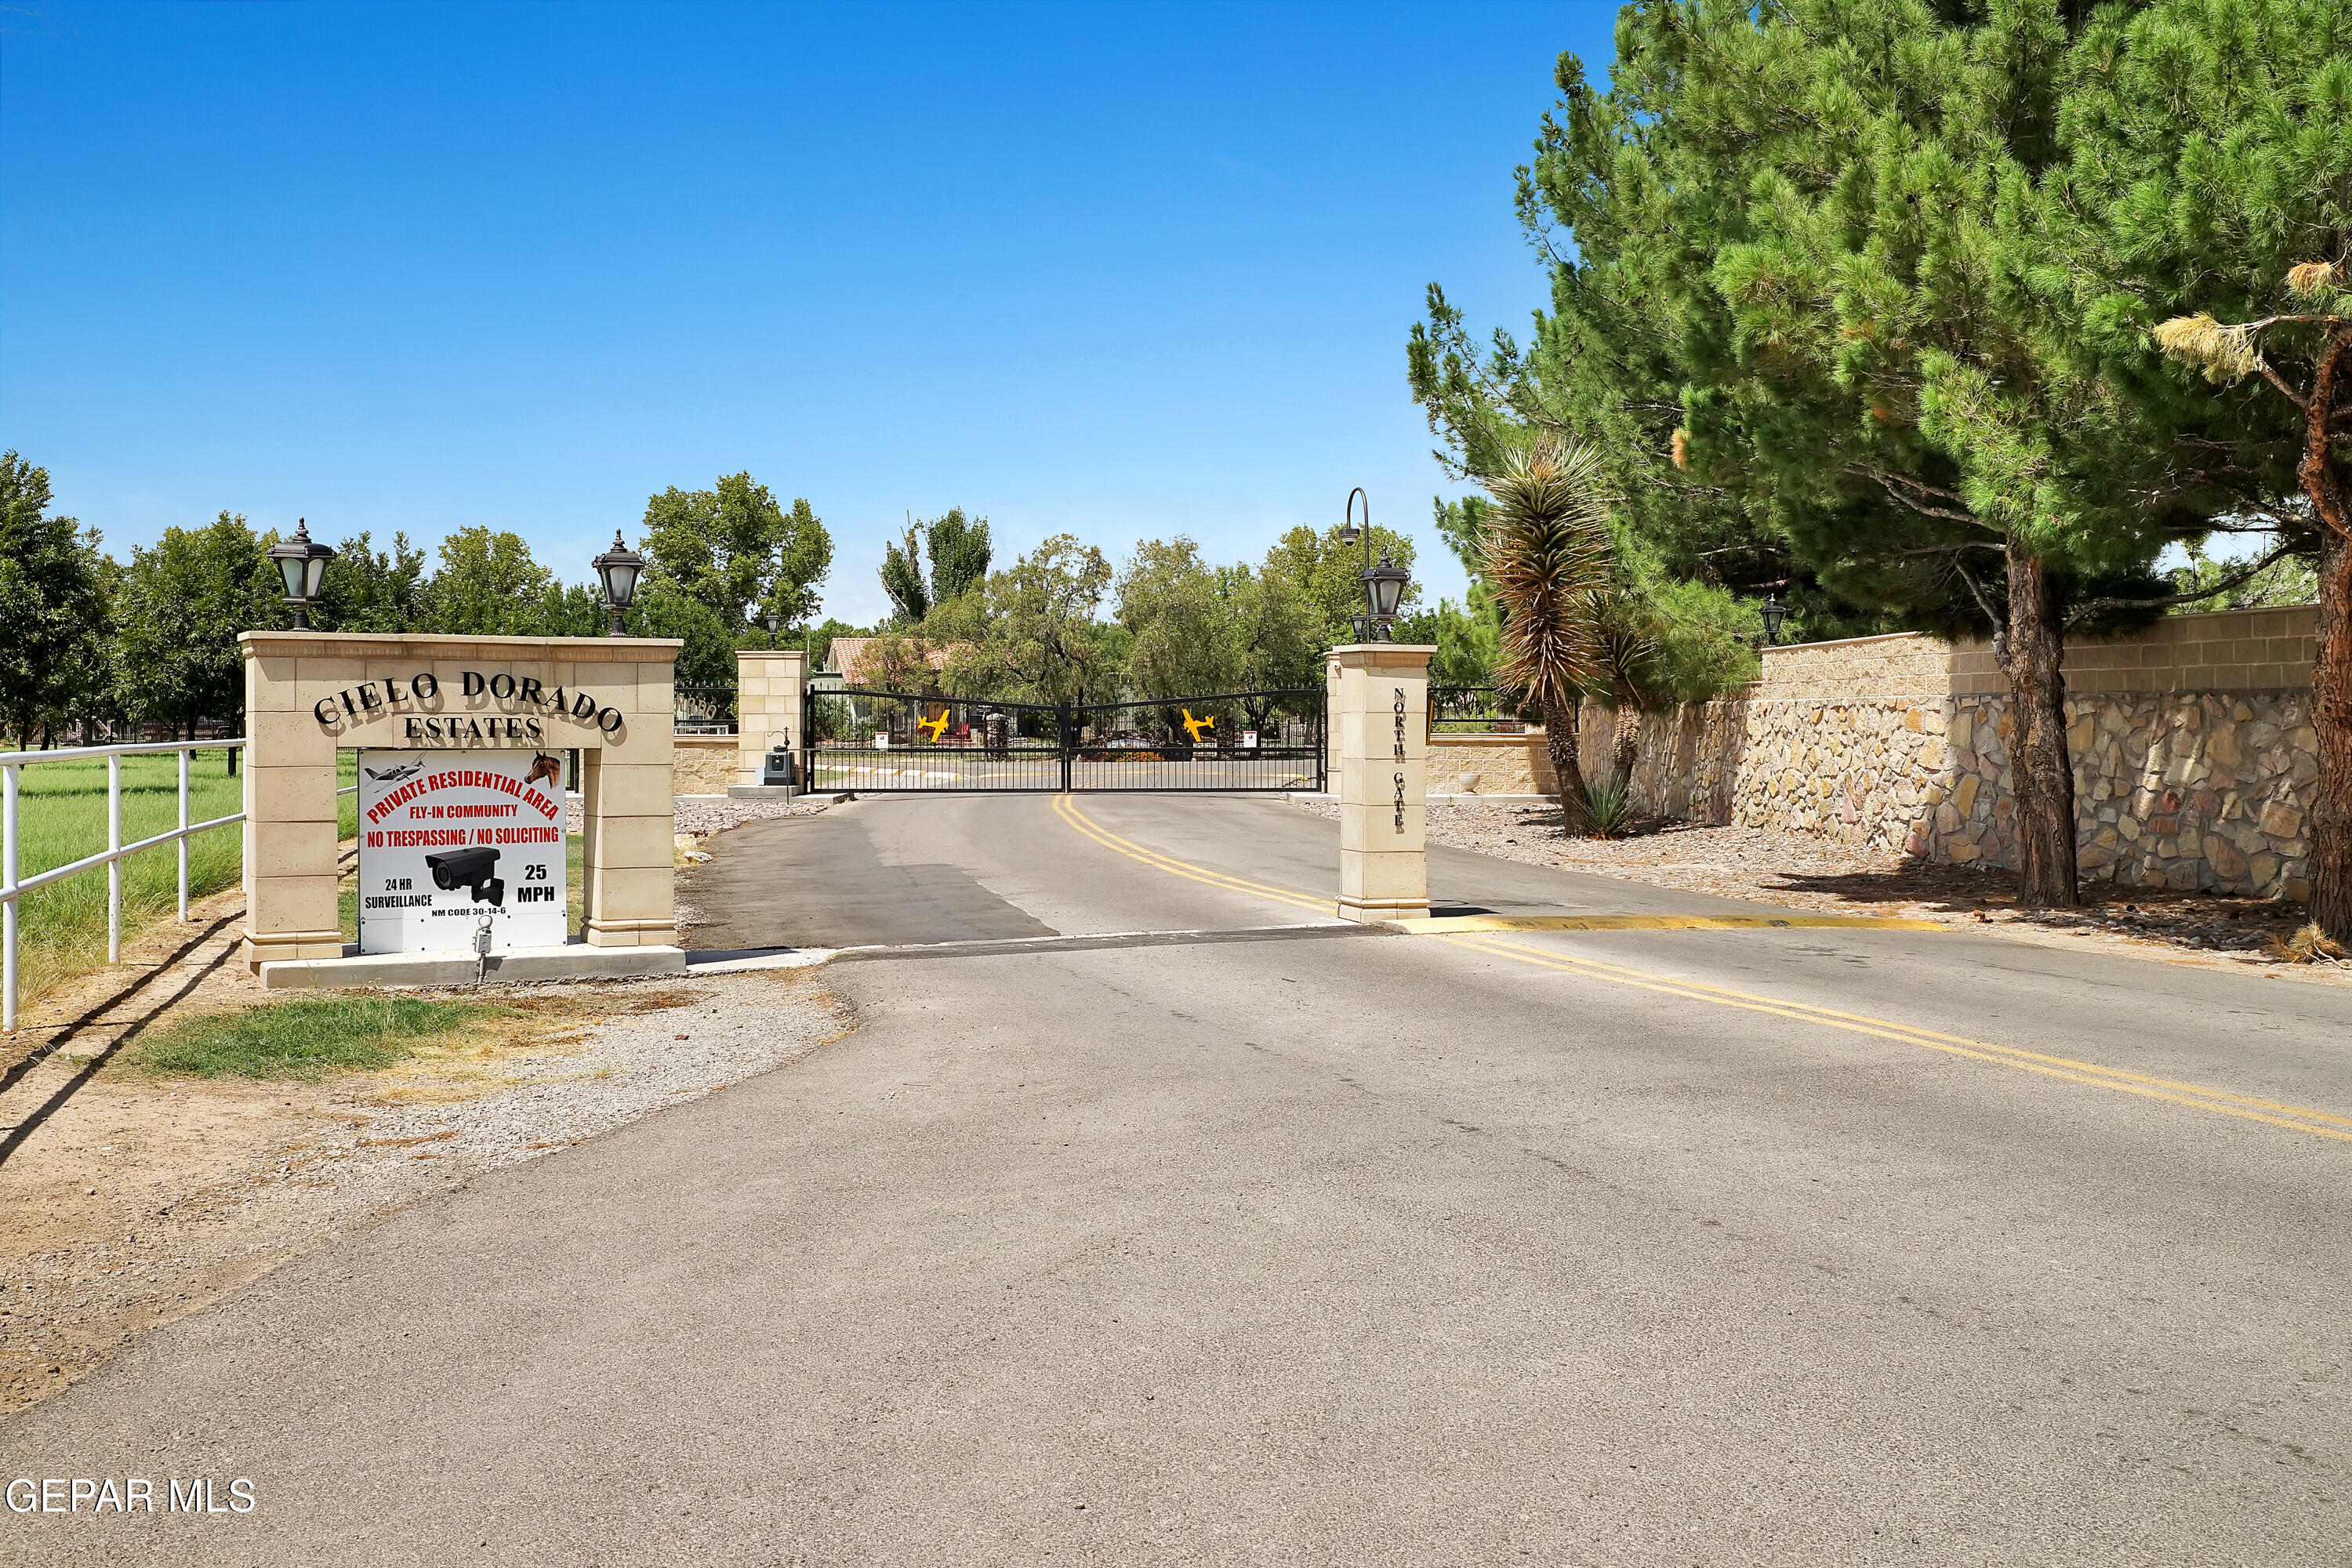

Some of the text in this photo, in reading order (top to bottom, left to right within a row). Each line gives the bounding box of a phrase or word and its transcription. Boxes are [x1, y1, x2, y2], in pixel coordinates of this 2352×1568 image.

[314, 671, 622, 732] CIELO DORADO
[405, 717, 541, 739] ESTATES
[1393, 688, 1404, 826] NORTH GATE
[366, 771, 559, 825] PRIVATE RESIDENTIAL AREA
[409, 804, 518, 819] FLY-IN COMMUNITY
[367, 826, 559, 848] NO TRESPASSING / NO SOLICITING
[524, 864, 547, 880] 25
[385, 878, 412, 891] 24 HR
[365, 895, 432, 909] SURVEILLANCE
[517, 886, 555, 902] MPH
[473, 907, 506, 916] 30-14-6
